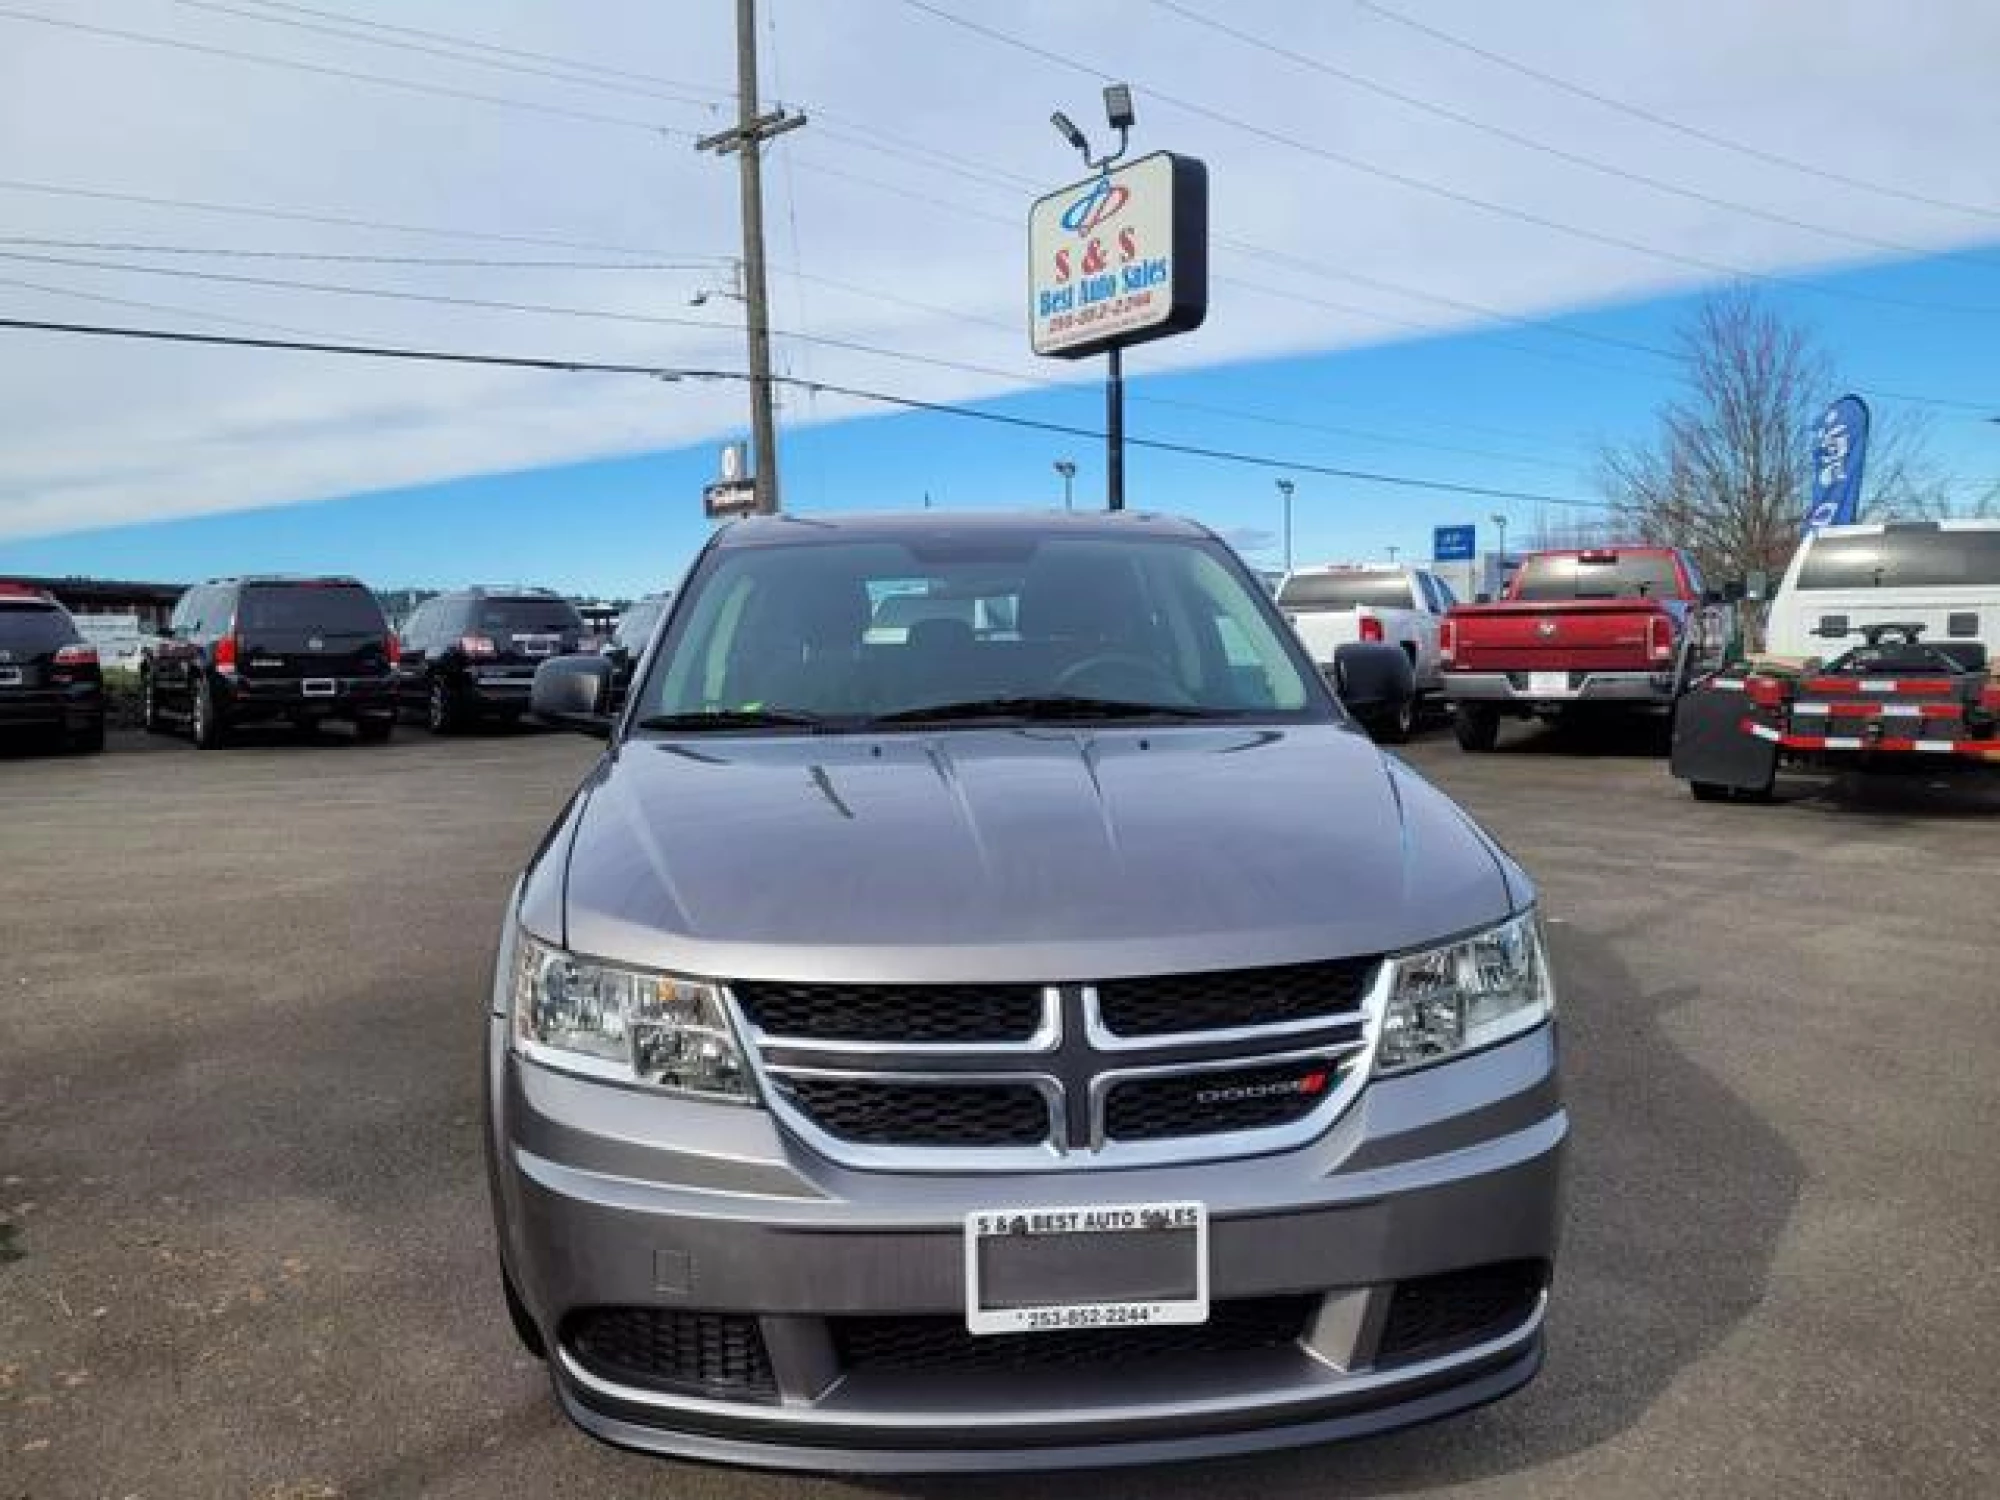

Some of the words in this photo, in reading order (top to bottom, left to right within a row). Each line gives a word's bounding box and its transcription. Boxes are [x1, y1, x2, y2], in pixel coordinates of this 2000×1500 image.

[1055, 249, 1070, 283] S
[1081, 238, 1106, 275] &
[1118, 227, 1135, 262] S
[1040, 284, 1072, 316] Best
[1122, 257, 1167, 292] Sales
[978, 1215, 989, 1231] S
[1032, 1213, 1078, 1230] BEST
[1085, 1210, 1135, 1228] AUTO
